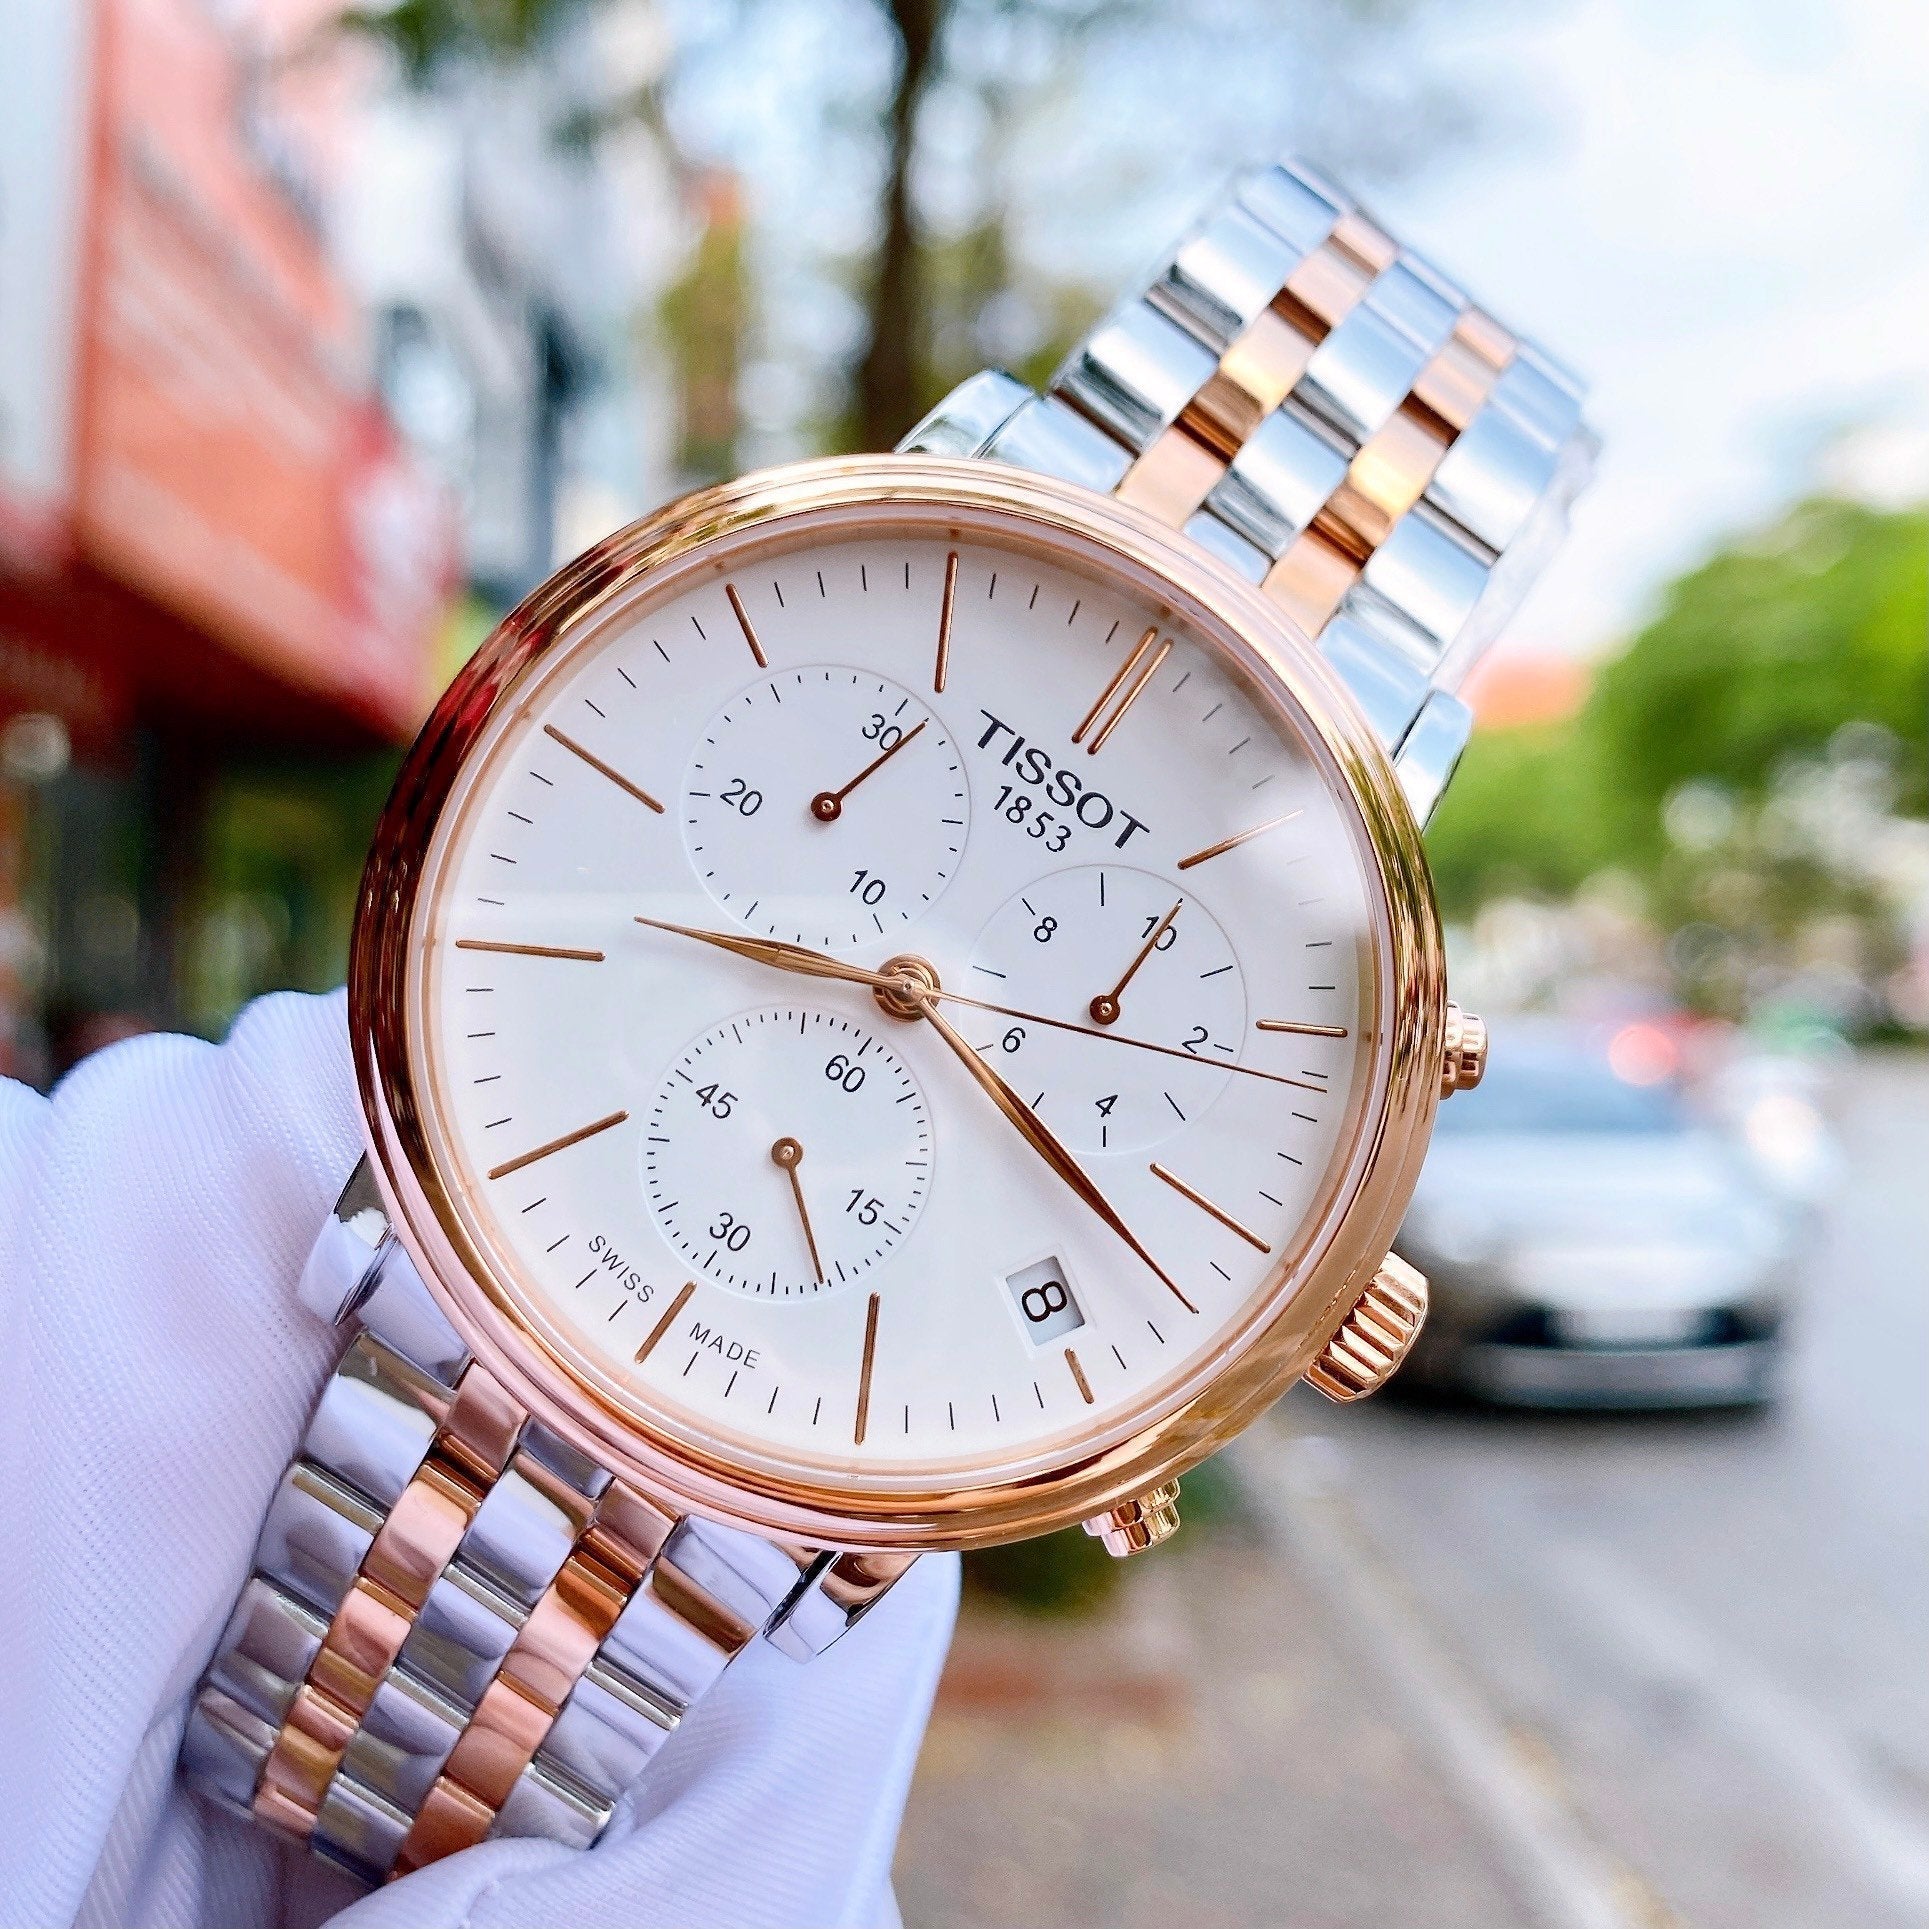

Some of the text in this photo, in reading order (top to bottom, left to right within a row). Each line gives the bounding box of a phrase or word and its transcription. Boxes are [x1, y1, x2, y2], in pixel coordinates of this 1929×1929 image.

[861, 713, 903, 751] 30
[720, 778, 763, 817] 20
[976, 710, 1150, 850] TISSOT
[993, 785, 1072, 853] 1853
[849, 869, 886, 906] 10
[1034, 916, 1058, 943] 8
[1141, 915, 1178, 951] 10
[1002, 1027, 1026, 1053] 6
[1182, 1025, 1209, 1055] 2
[825, 1054, 866, 1093] 60
[695, 1084, 738, 1120] 45
[1095, 1094, 1119, 1118] 4
[847, 1189, 885, 1225] 15
[709, 1213, 751, 1251] 30
[588, 1234, 761, 1369] SWISS MADE
[1021, 1280, 1068, 1323] 8
